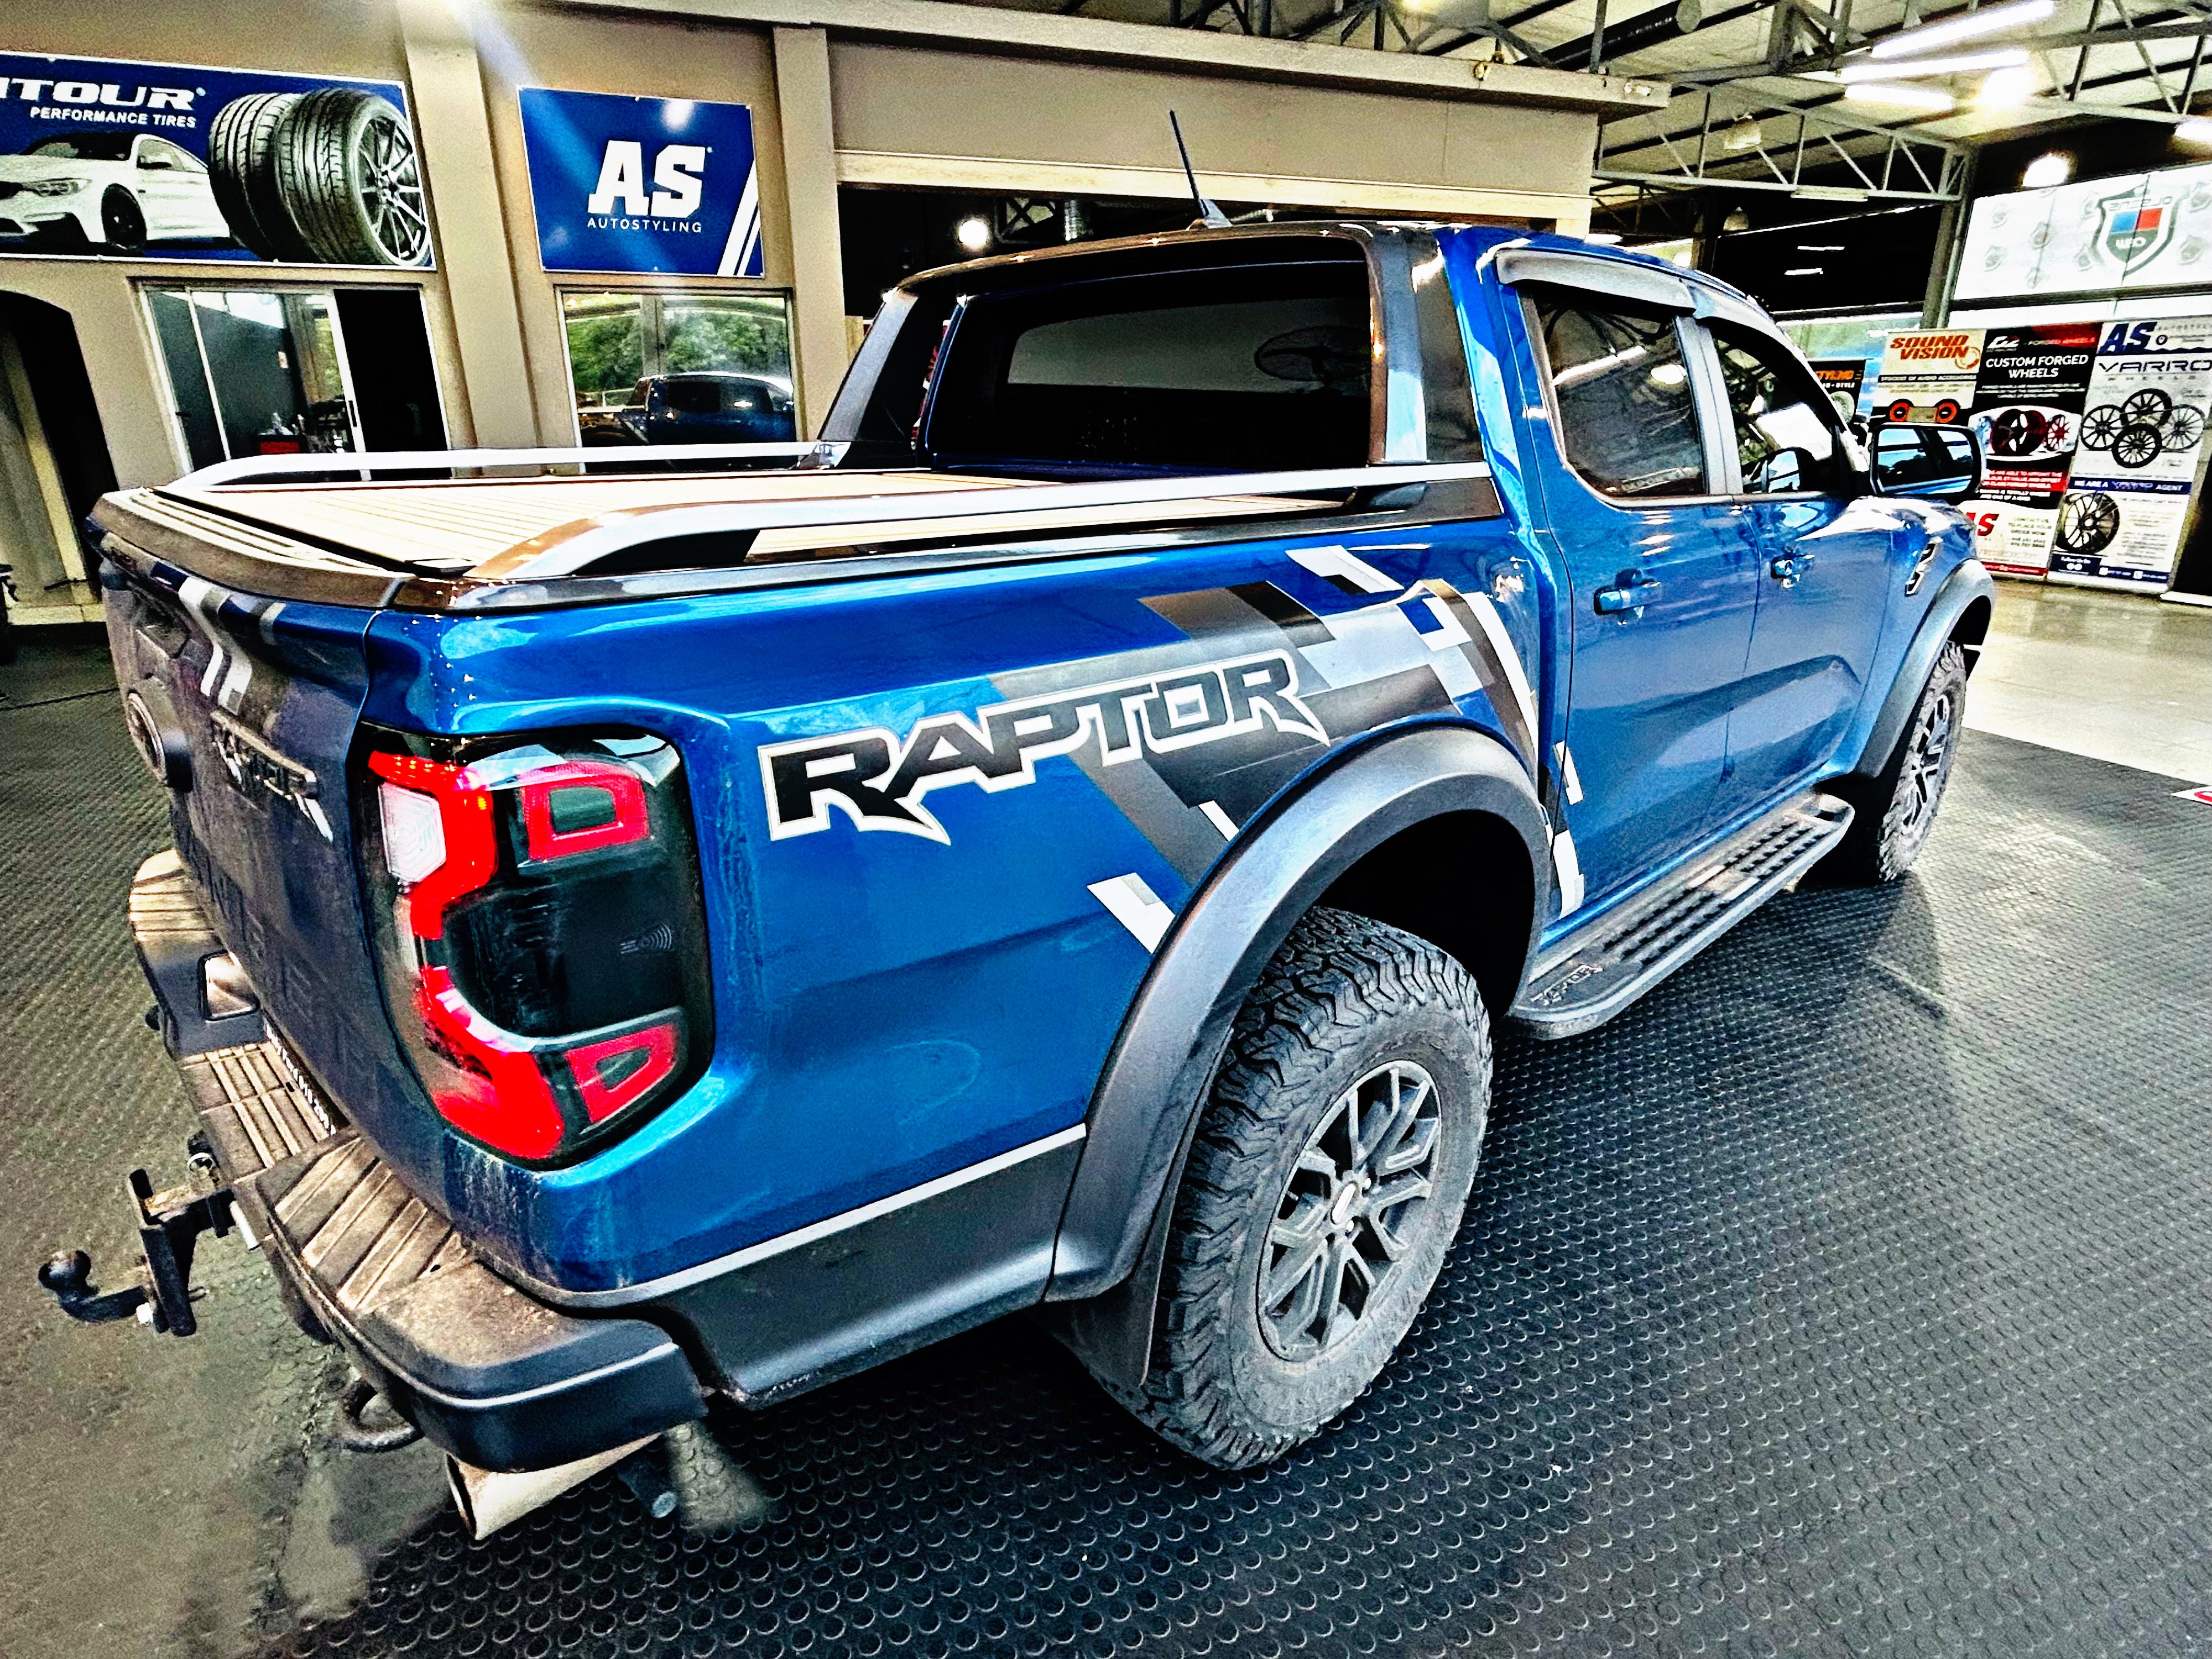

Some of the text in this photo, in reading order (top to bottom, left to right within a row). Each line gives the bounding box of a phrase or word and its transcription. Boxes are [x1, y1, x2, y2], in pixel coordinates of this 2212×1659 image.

[30, 106, 196, 128] PERFORMANCE TIRES
[588, 140, 706, 218] AS
[587, 217, 701, 233] AUTOSTYLING
[1890, 335, 1969, 349] SOUND
[2098, 321, 2158, 354] AS
[1900, 346, 1970, 360] VISION
[1986, 354, 2089, 368] CUSTOM FORGED
[2008, 367, 2059, 379] WHEELS
[758, 649, 1331, 846] RAPTOR
